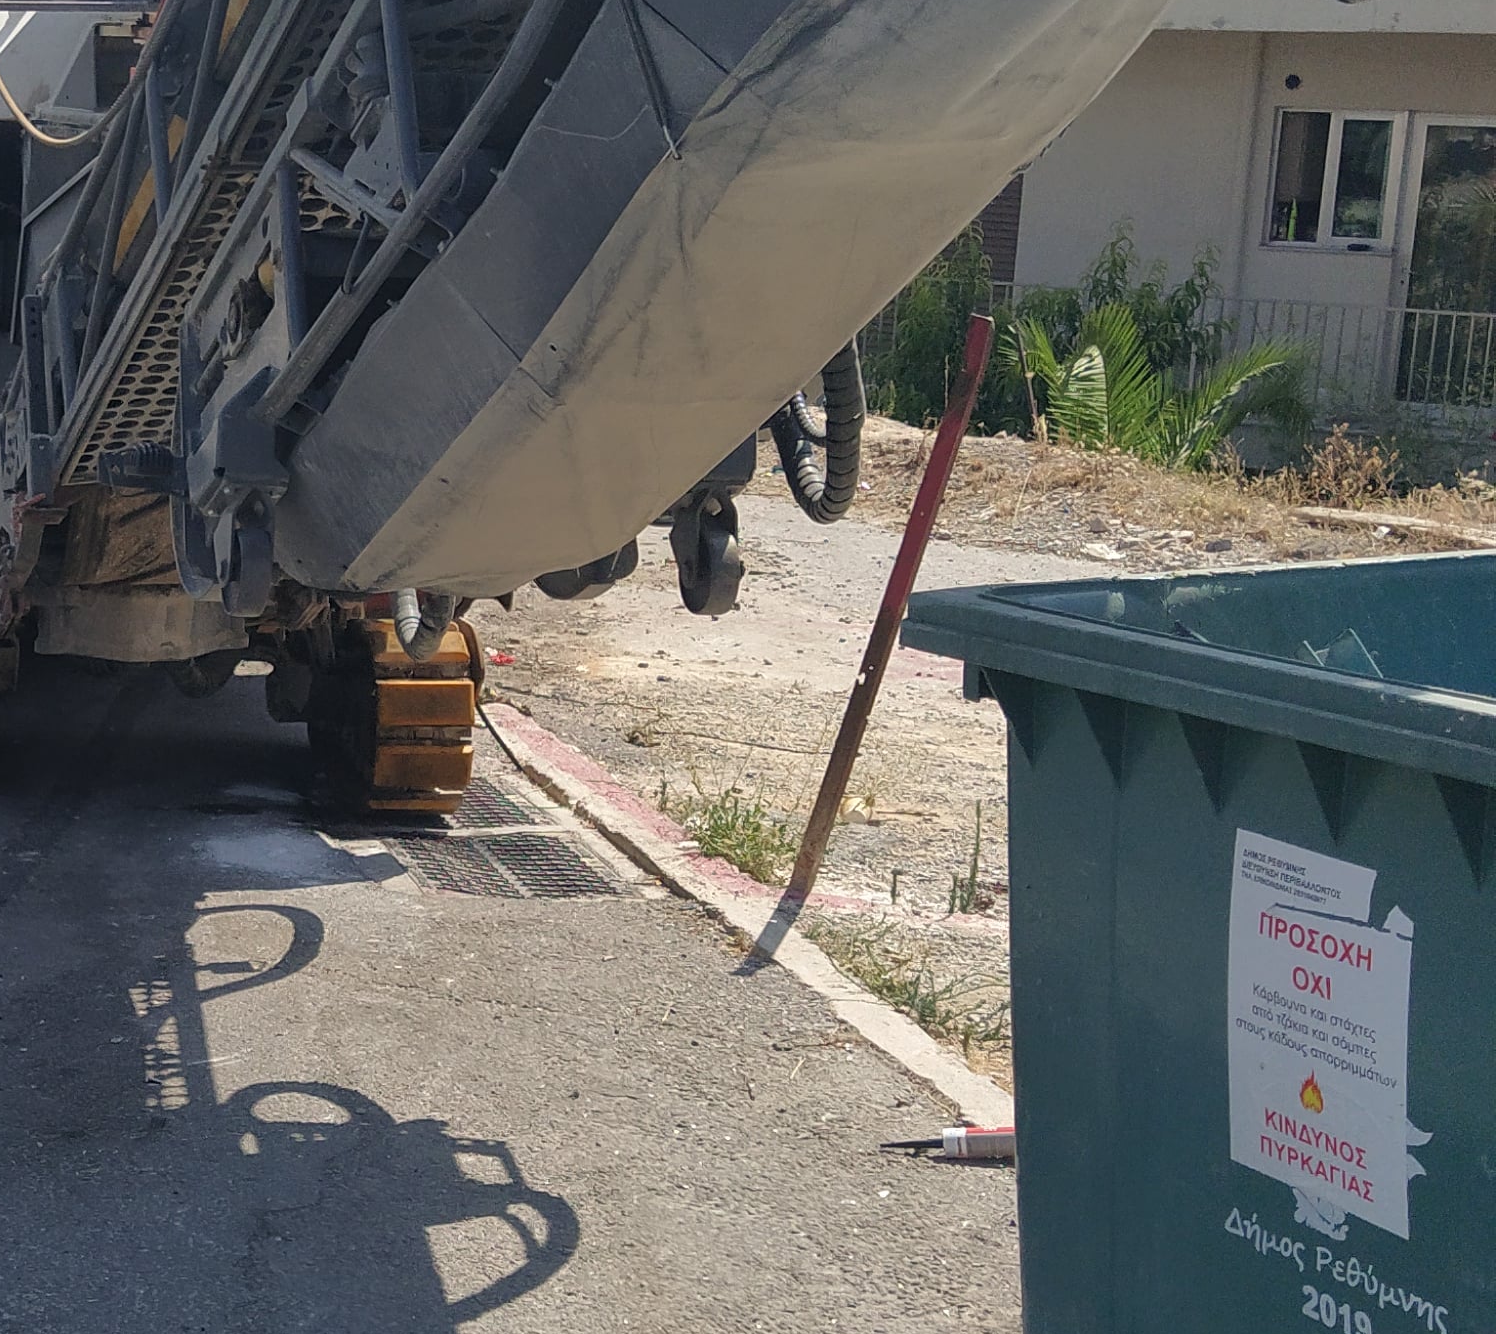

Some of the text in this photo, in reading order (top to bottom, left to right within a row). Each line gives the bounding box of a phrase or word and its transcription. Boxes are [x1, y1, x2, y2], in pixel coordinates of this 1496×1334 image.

[1259, 911, 1372, 971] ΠΡΟΣΟΧΗ
[1252, 983, 1376, 1043] Κάρβουνα και στάχτες
[1292, 966, 1331, 1000] ΟΧΙ
[1236, 1017, 1397, 1089] στους κάδους απορριμμάτων
[1252, 1004, 1377, 1064] από τζάκια και σόμπες
[1259, 1134, 1374, 1202] ΠΥΡΚΑΓΙΑΣ
[1264, 1107, 1367, 1170] ΚΙΝΔΥΝΟΣ
[1224, 1207, 1305, 1272] Δήμος
